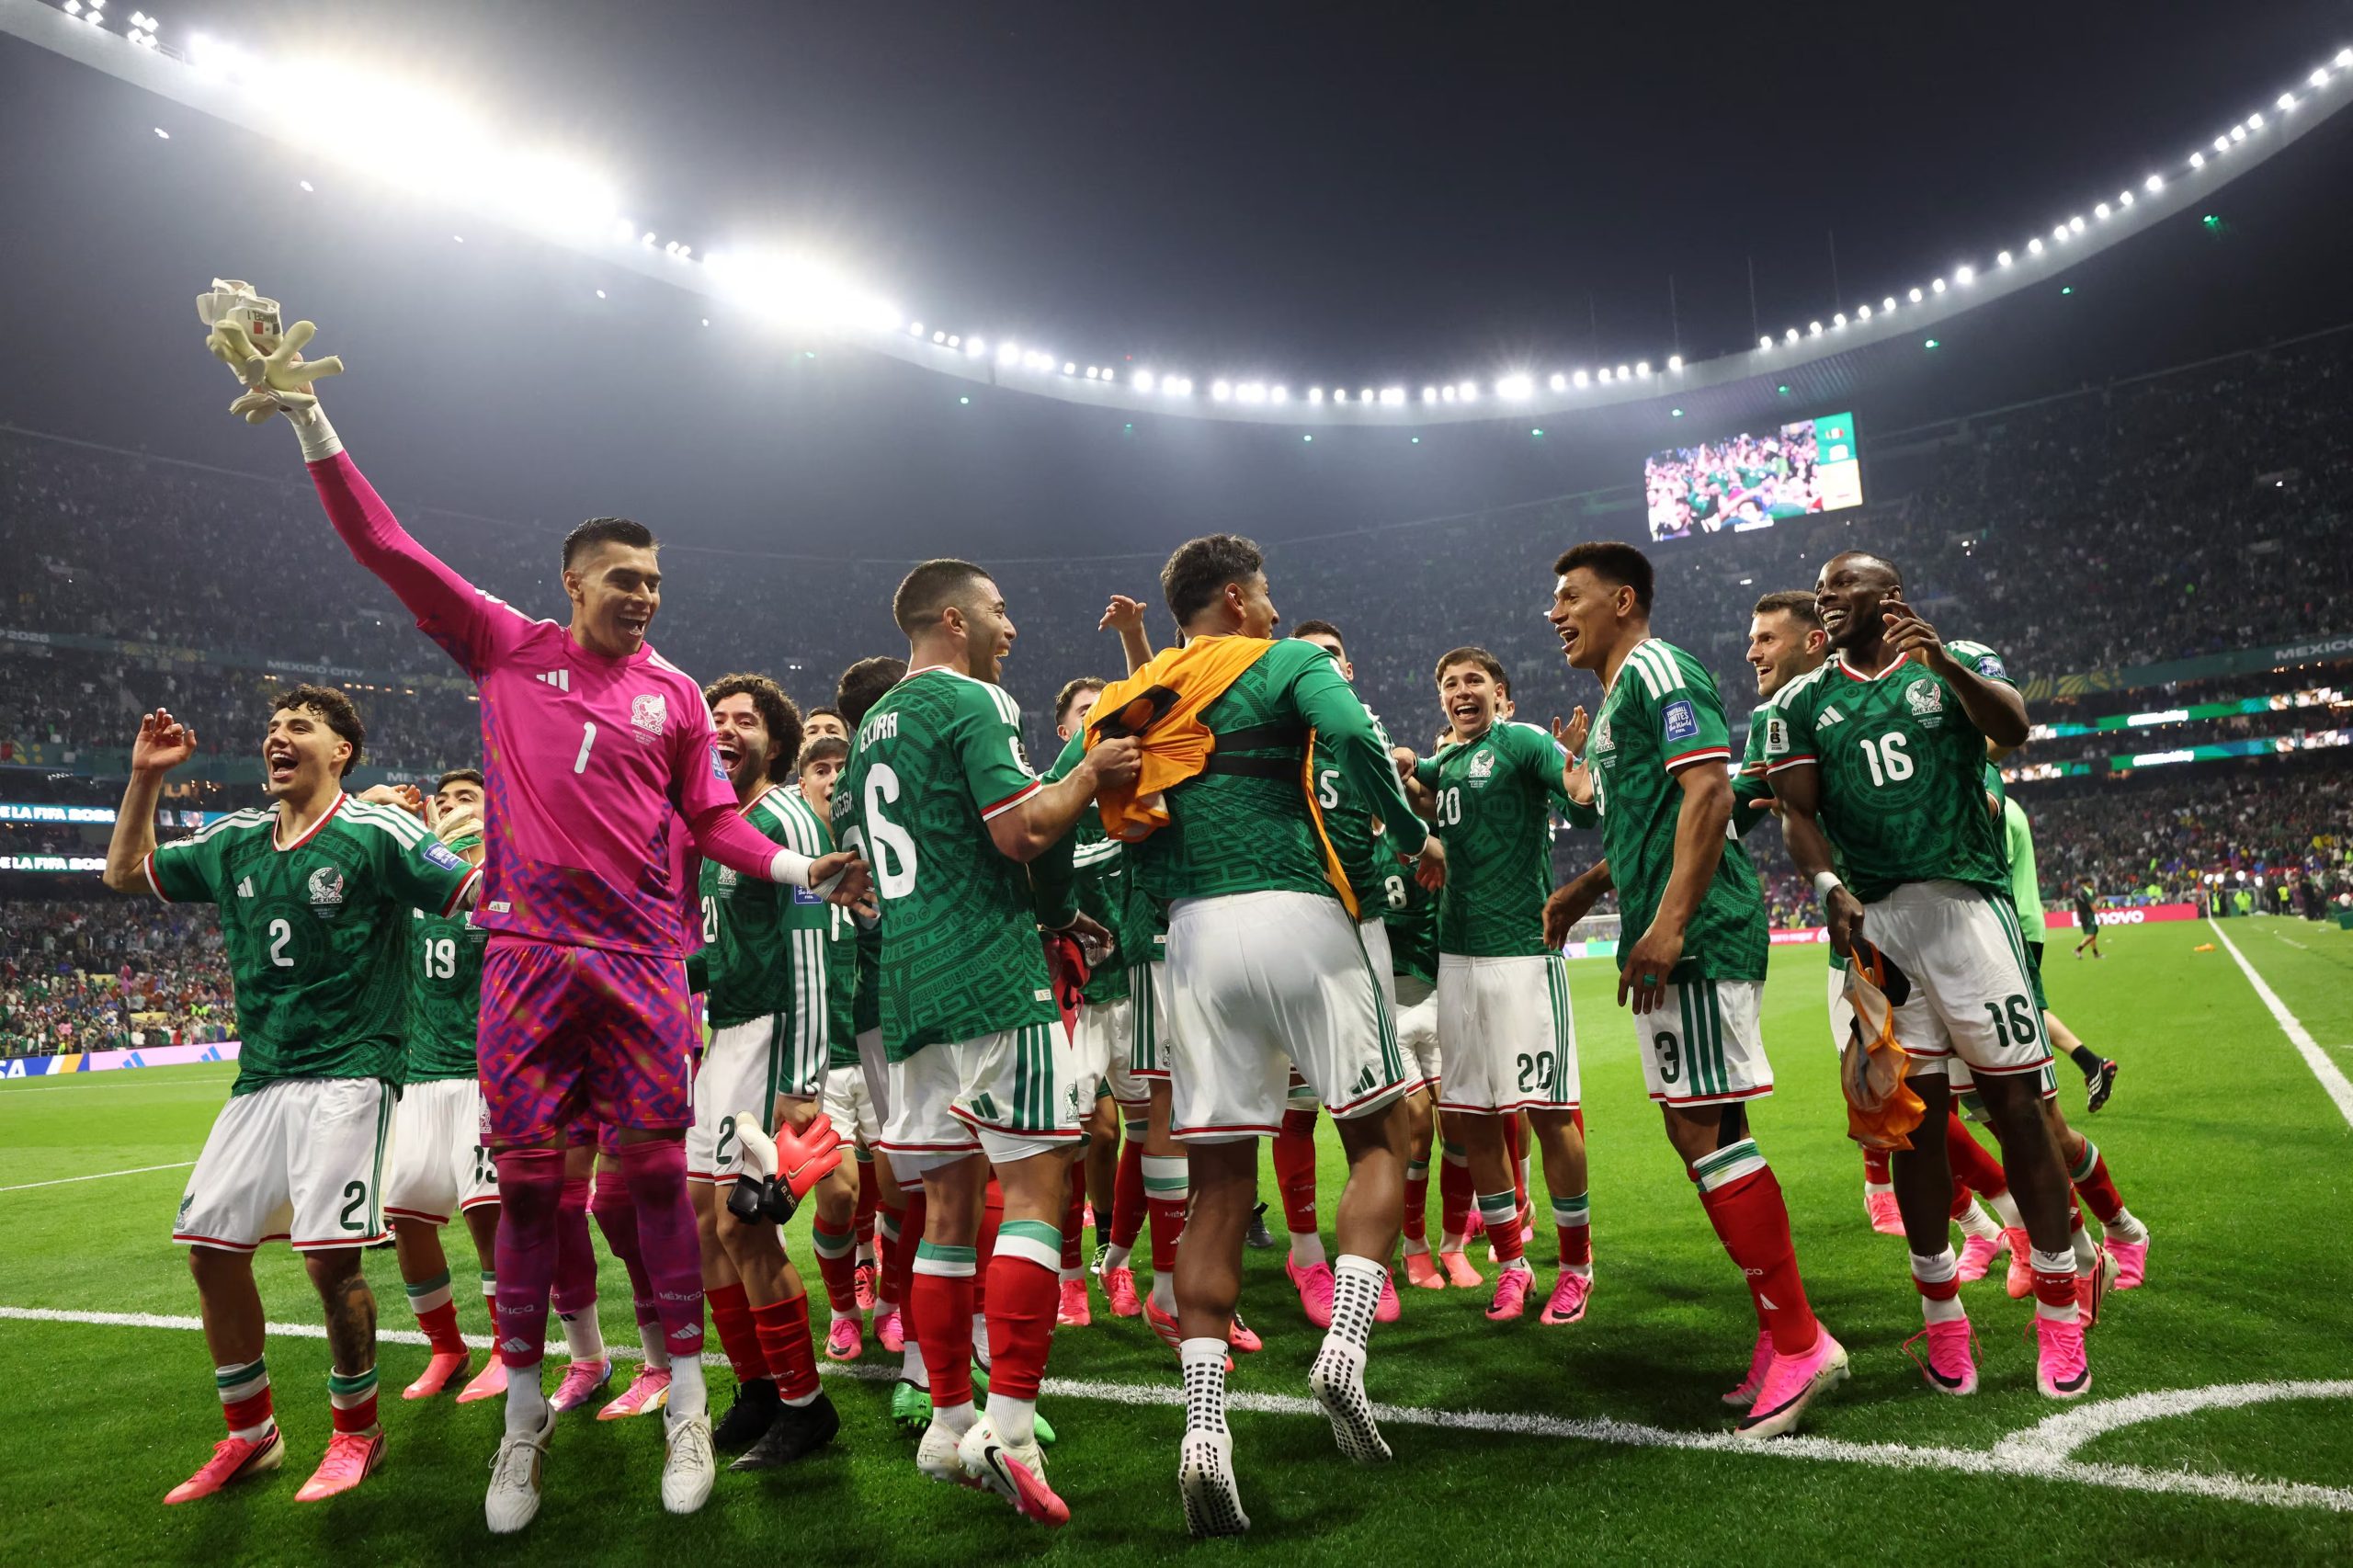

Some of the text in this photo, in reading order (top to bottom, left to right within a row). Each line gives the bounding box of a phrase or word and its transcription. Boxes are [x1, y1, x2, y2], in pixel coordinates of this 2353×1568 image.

[267, 660, 364, 678] MEXICO CITY
[574, 722, 597, 774] 1
[1859, 732, 1915, 787] 16
[1319, 770, 1339, 809] 5
[1436, 787, 1461, 827] 20
[12, 807, 32, 819] LA
[34, 807, 66, 820] FIFA
[865, 763, 917, 900] 6
[12, 858, 33, 869] LA
[34, 858, 67, 870] FIFA
[2072, 910, 2144, 927] Lnovo
[269, 919, 294, 966] 2
[426, 938, 455, 979] 19
[1984, 994, 2036, 1047] 16
[1517, 1051, 1554, 1093] 20
[1655, 1030, 1680, 1085] 3
[684, 1053, 692, 1108] 1
[340, 1180, 366, 1230] 2
